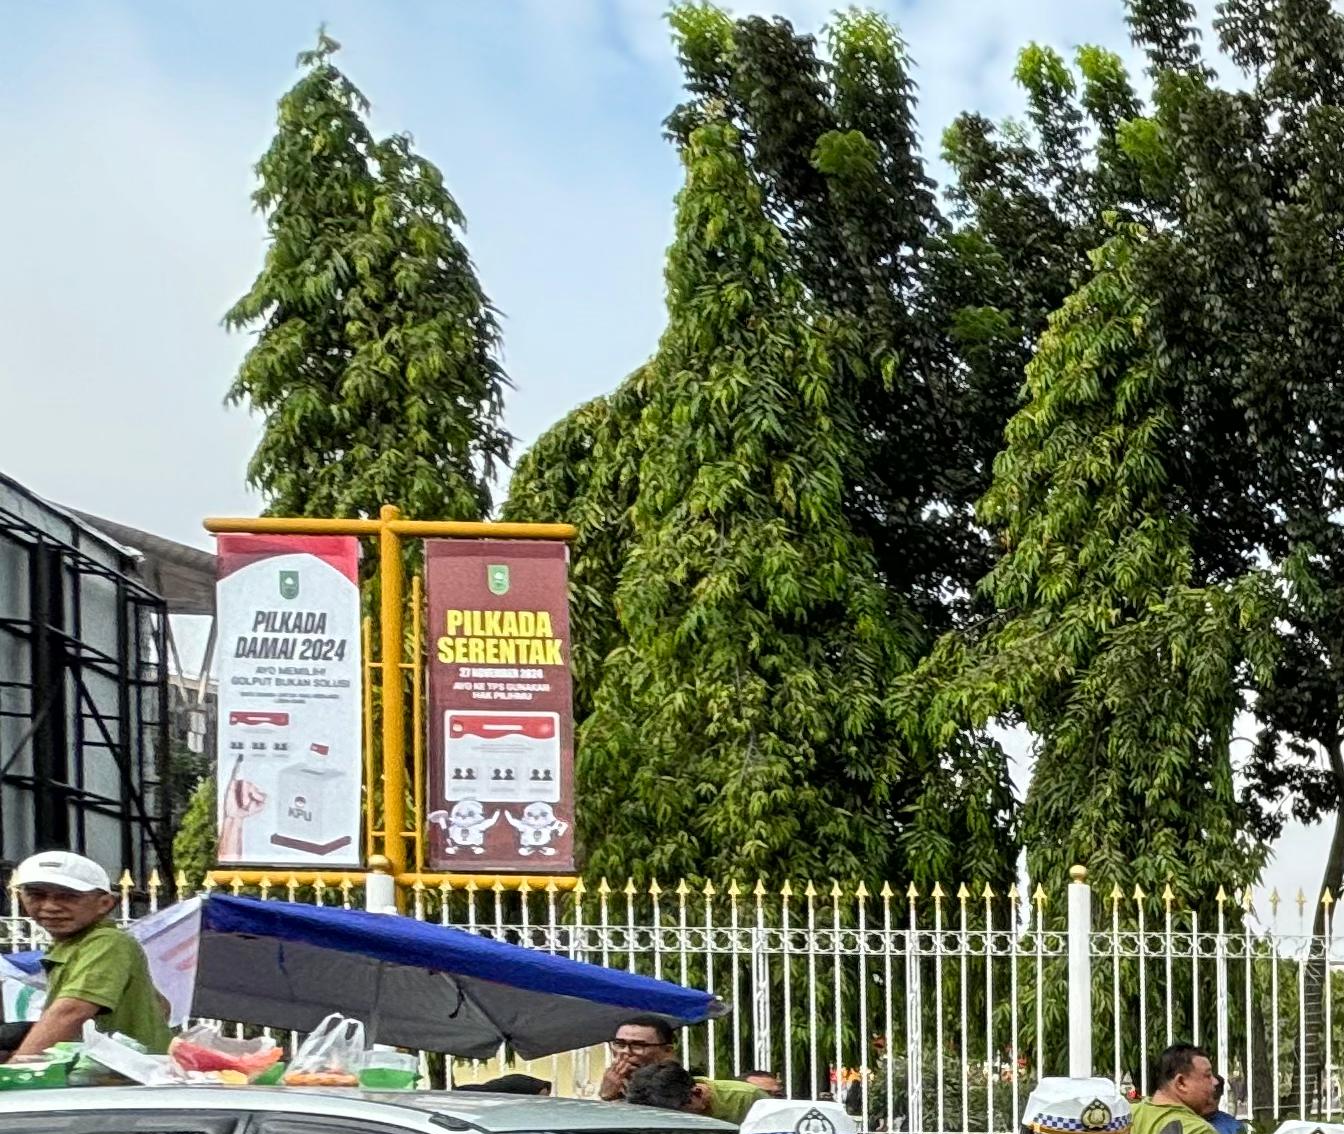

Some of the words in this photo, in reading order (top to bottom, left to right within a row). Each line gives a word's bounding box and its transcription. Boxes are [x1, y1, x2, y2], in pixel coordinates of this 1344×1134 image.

[252, 610, 327, 635] PILKADA
[446, 609, 554, 638] PILKADA
[234, 636, 298, 660] DAMAI
[298, 638, 347, 661] 2024
[437, 636, 565, 666] SERENTAK
